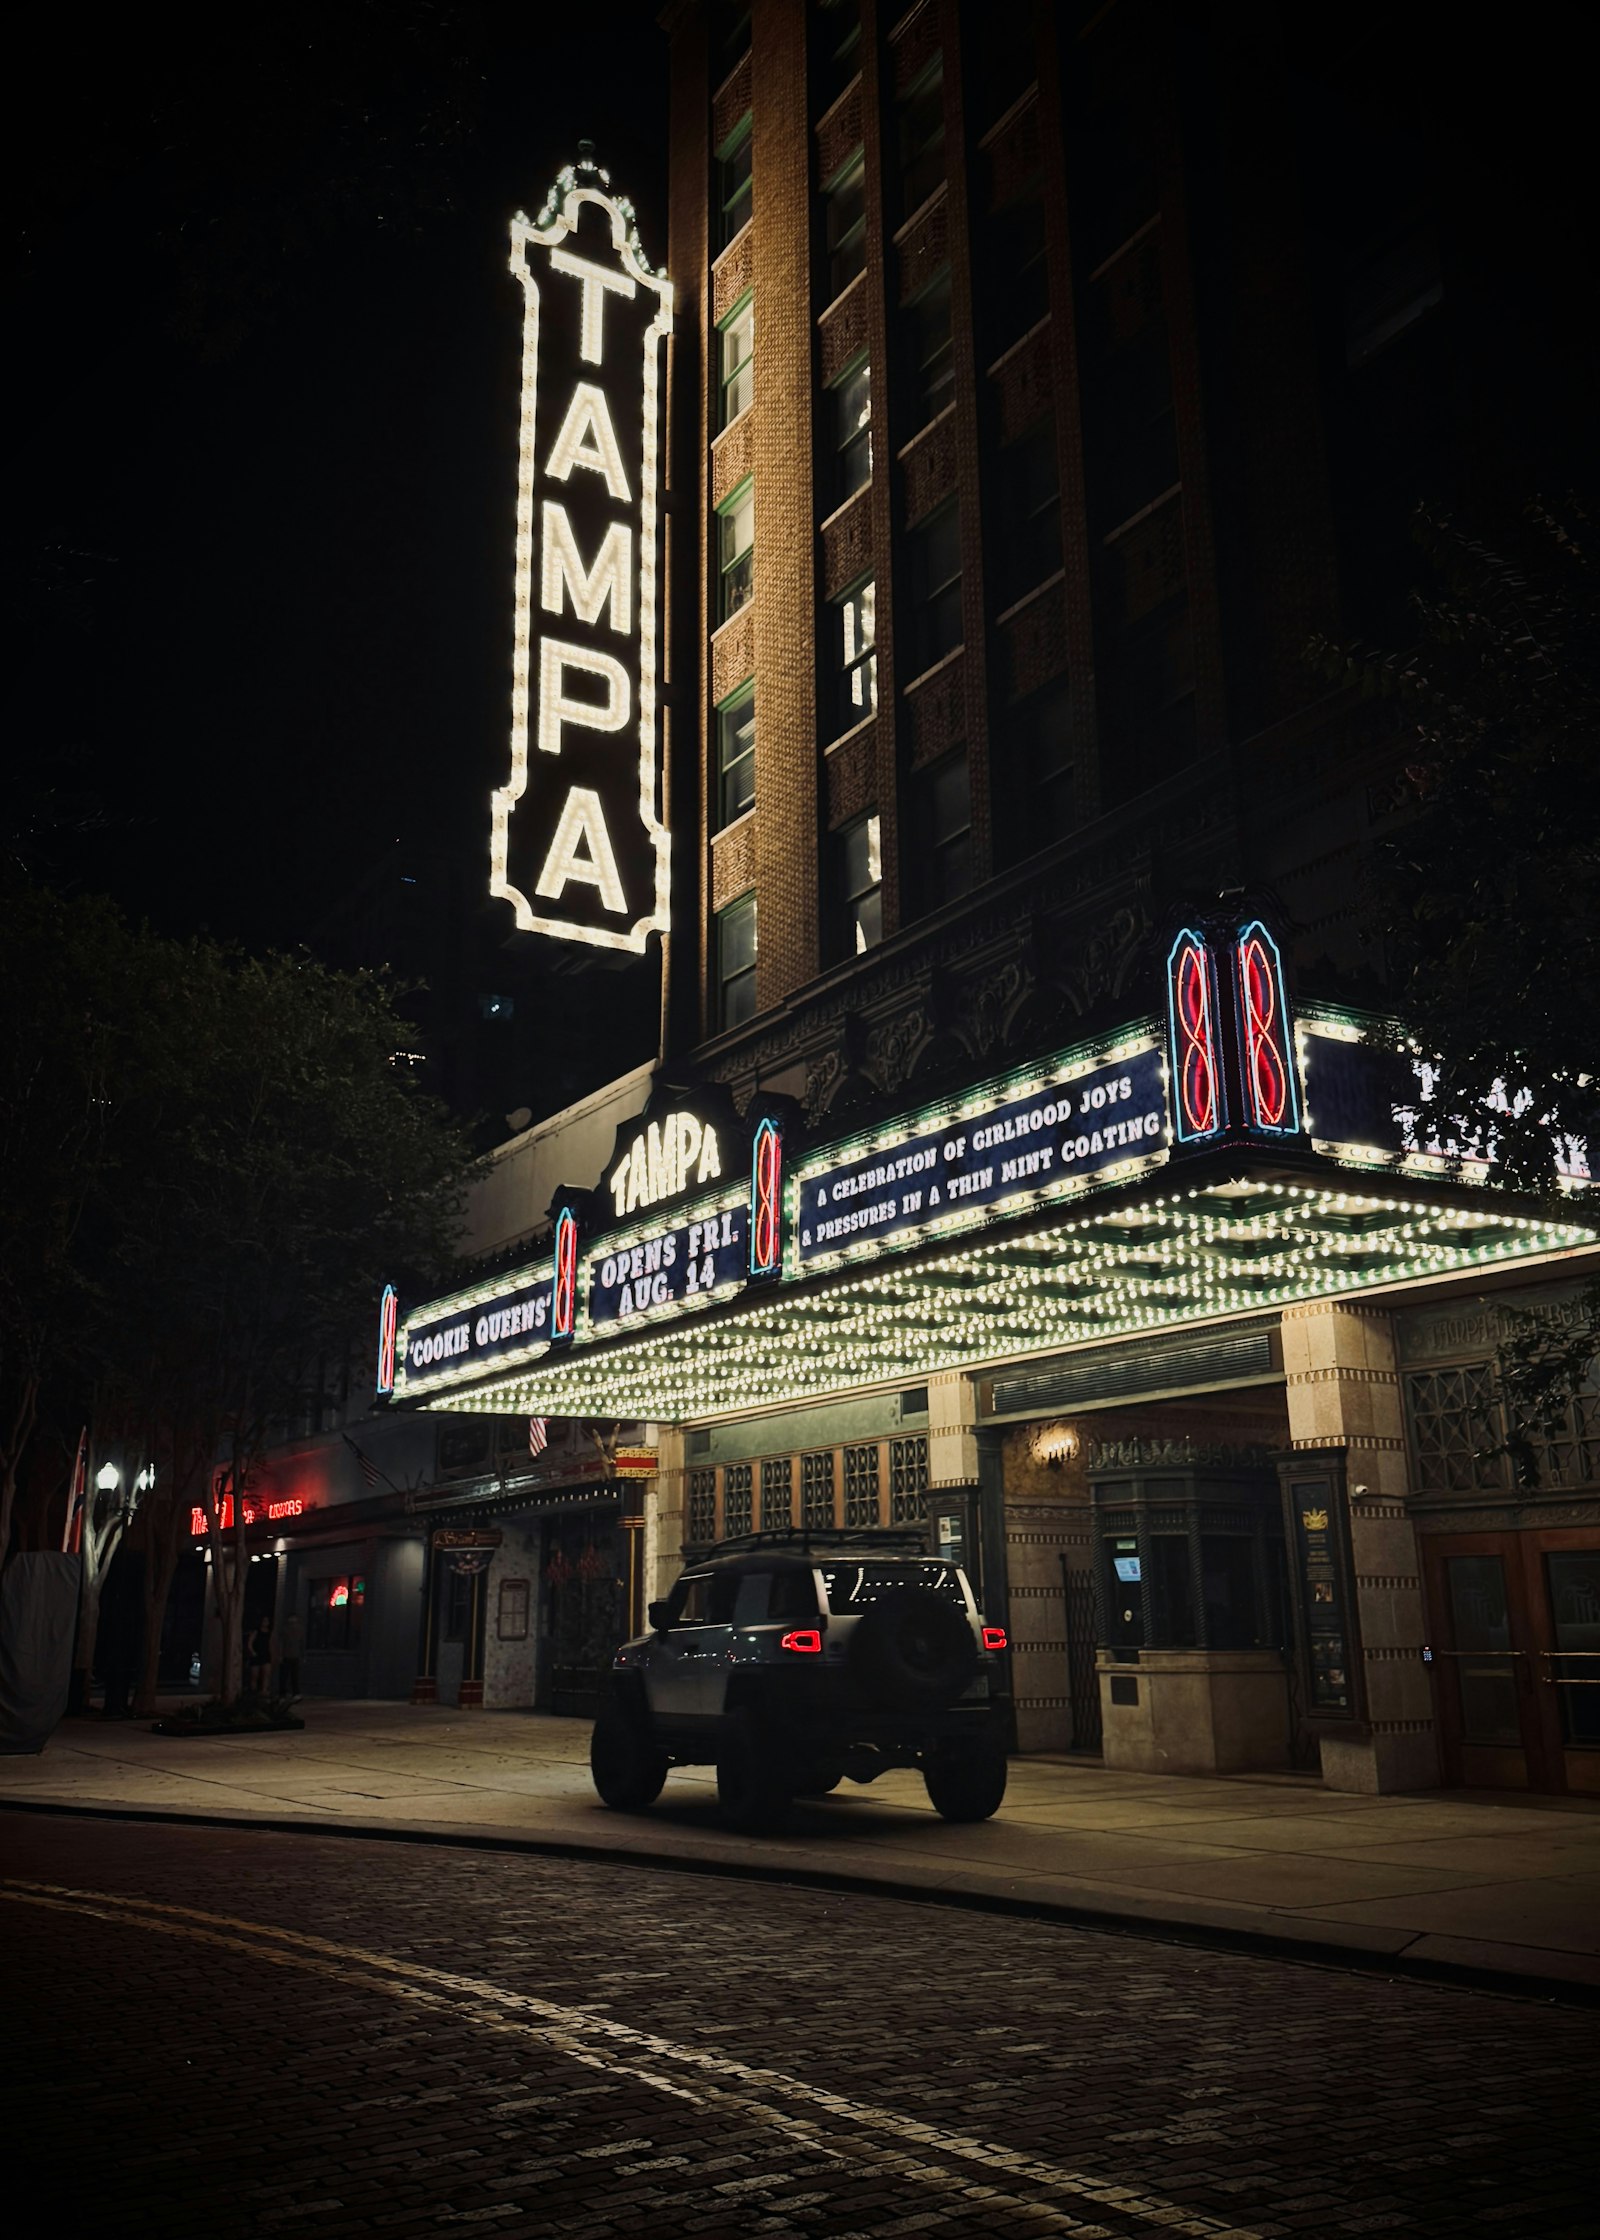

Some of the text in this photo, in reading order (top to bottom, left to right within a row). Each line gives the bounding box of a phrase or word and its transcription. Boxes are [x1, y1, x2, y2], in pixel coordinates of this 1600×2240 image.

[535, 245, 637, 917] TAMPA
[610, 1111, 721, 1218] TAMPA
[801, 1112, 1160, 1248] & PRESSURES IN A THIN MINT COATING
[816, 1076, 1132, 1207] A CELEBRATION OF GIRLHOOD JOYS
[601, 1213, 739, 1289] OPENS FRI.
[618, 1255, 716, 1318] AUG. 14
